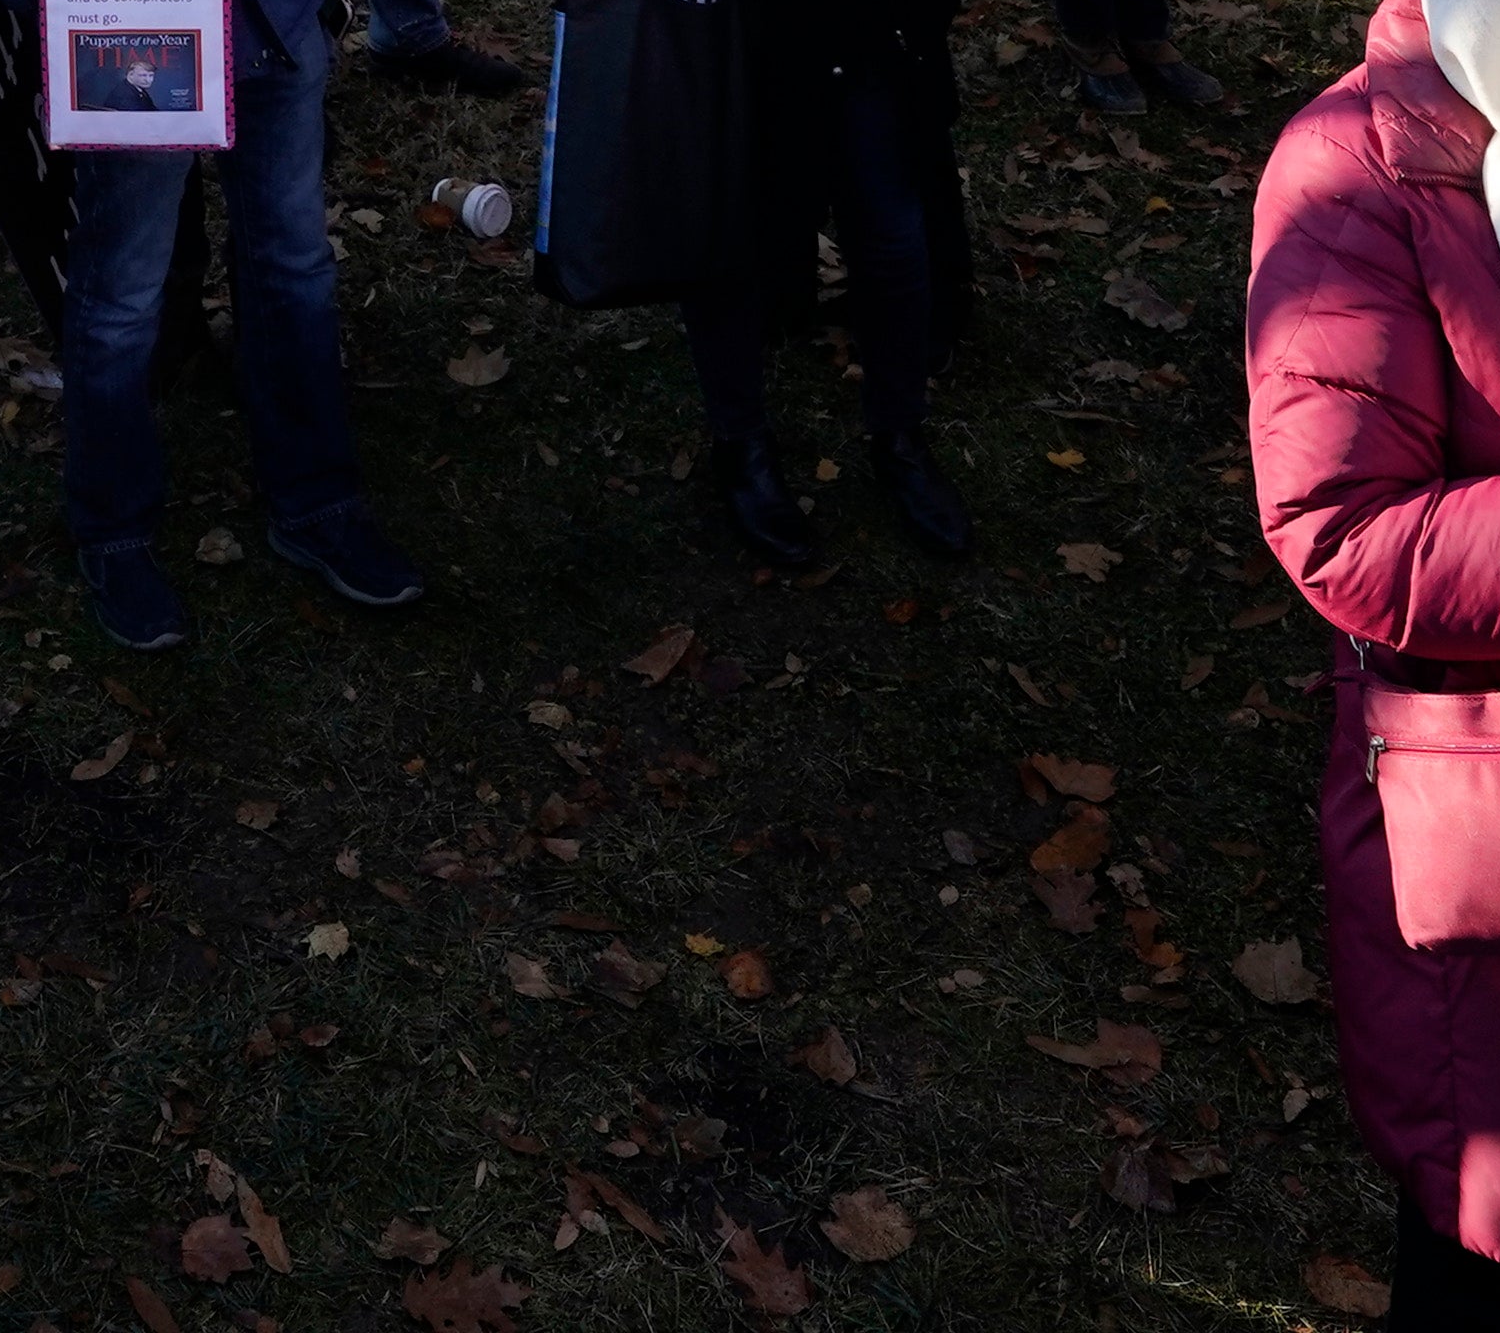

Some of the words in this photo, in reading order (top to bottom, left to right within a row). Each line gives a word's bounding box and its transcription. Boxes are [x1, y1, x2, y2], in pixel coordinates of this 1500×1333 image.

[68, 13, 99, 24] must
[102, 14, 122, 26] go.
[79, 35, 128, 48] Puppet
[130, 36, 142, 46] of
[143, 36, 159, 46] the
[160, 35, 191, 46] Year
